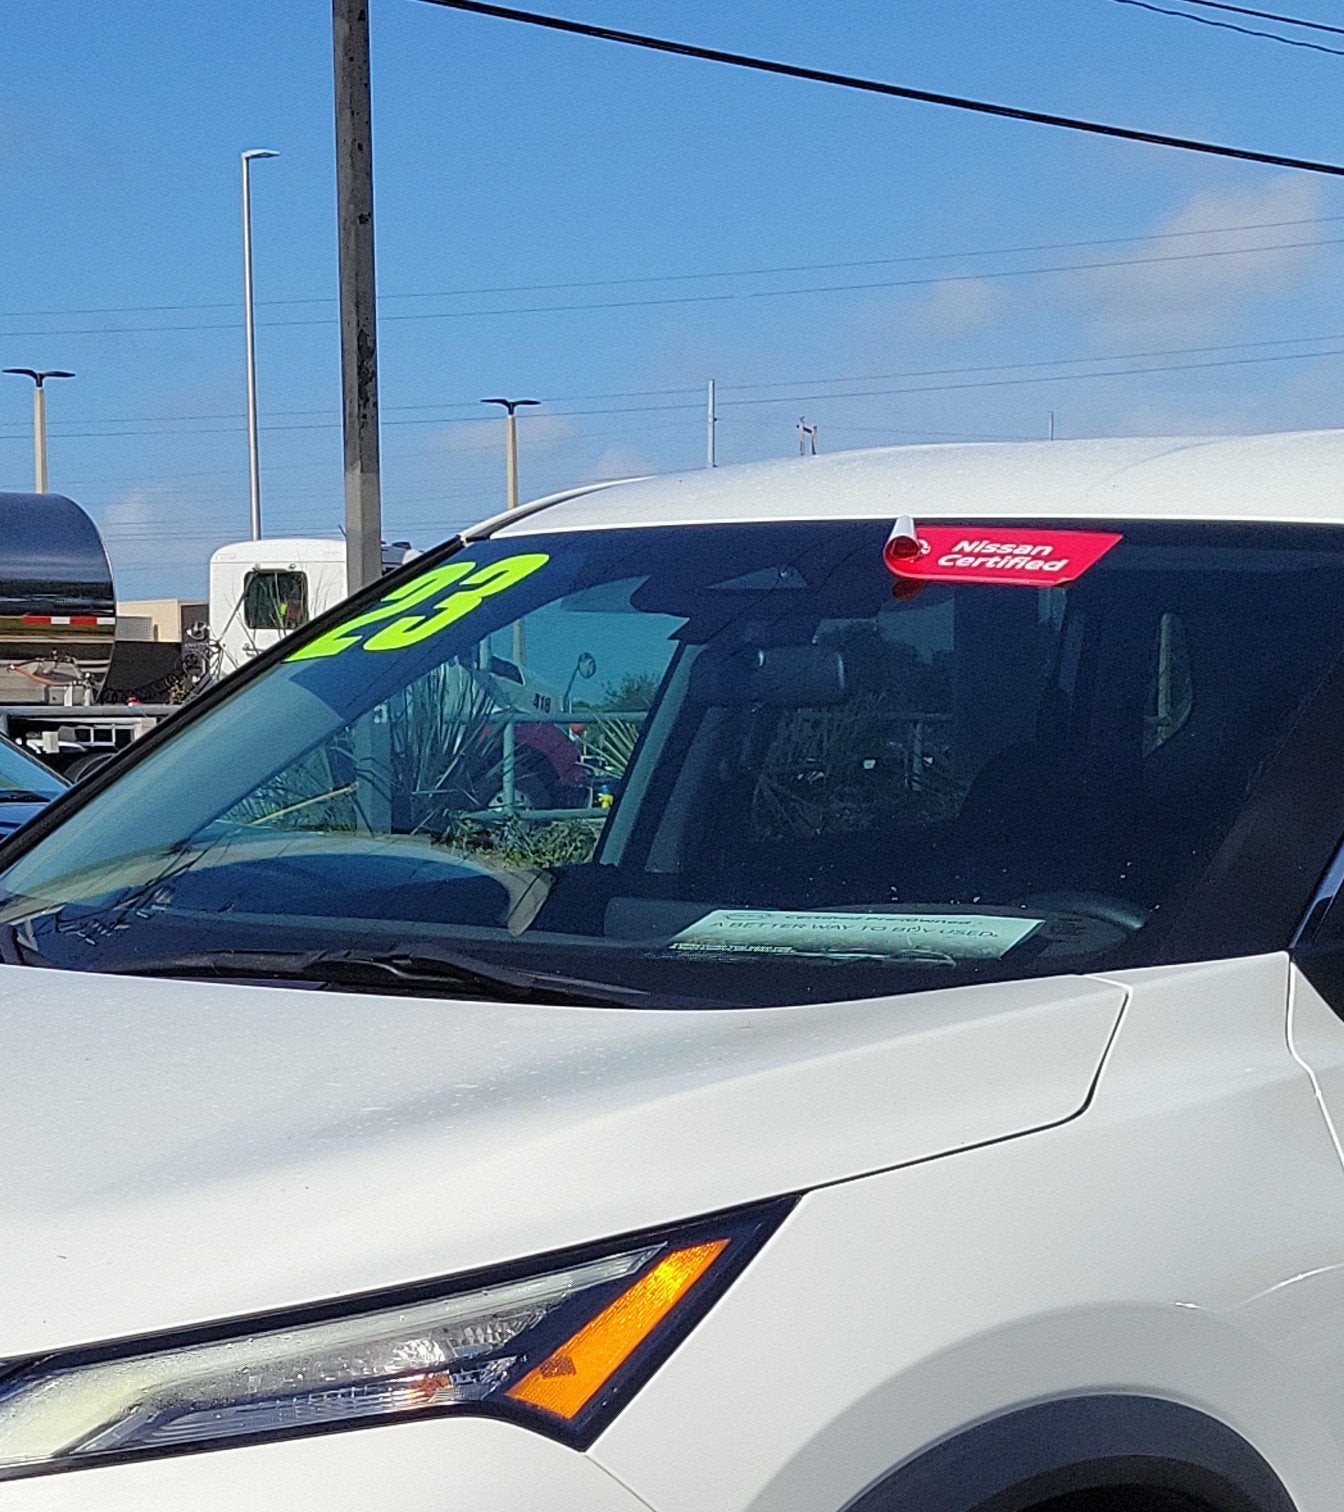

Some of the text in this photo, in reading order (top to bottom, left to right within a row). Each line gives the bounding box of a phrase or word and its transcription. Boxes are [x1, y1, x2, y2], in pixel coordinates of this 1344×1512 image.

[951, 539, 1054, 556] Nissan
[937, 554, 1069, 572] Certified
[282, 553, 550, 663] 23
[729, 922, 807, 930] BETTER
